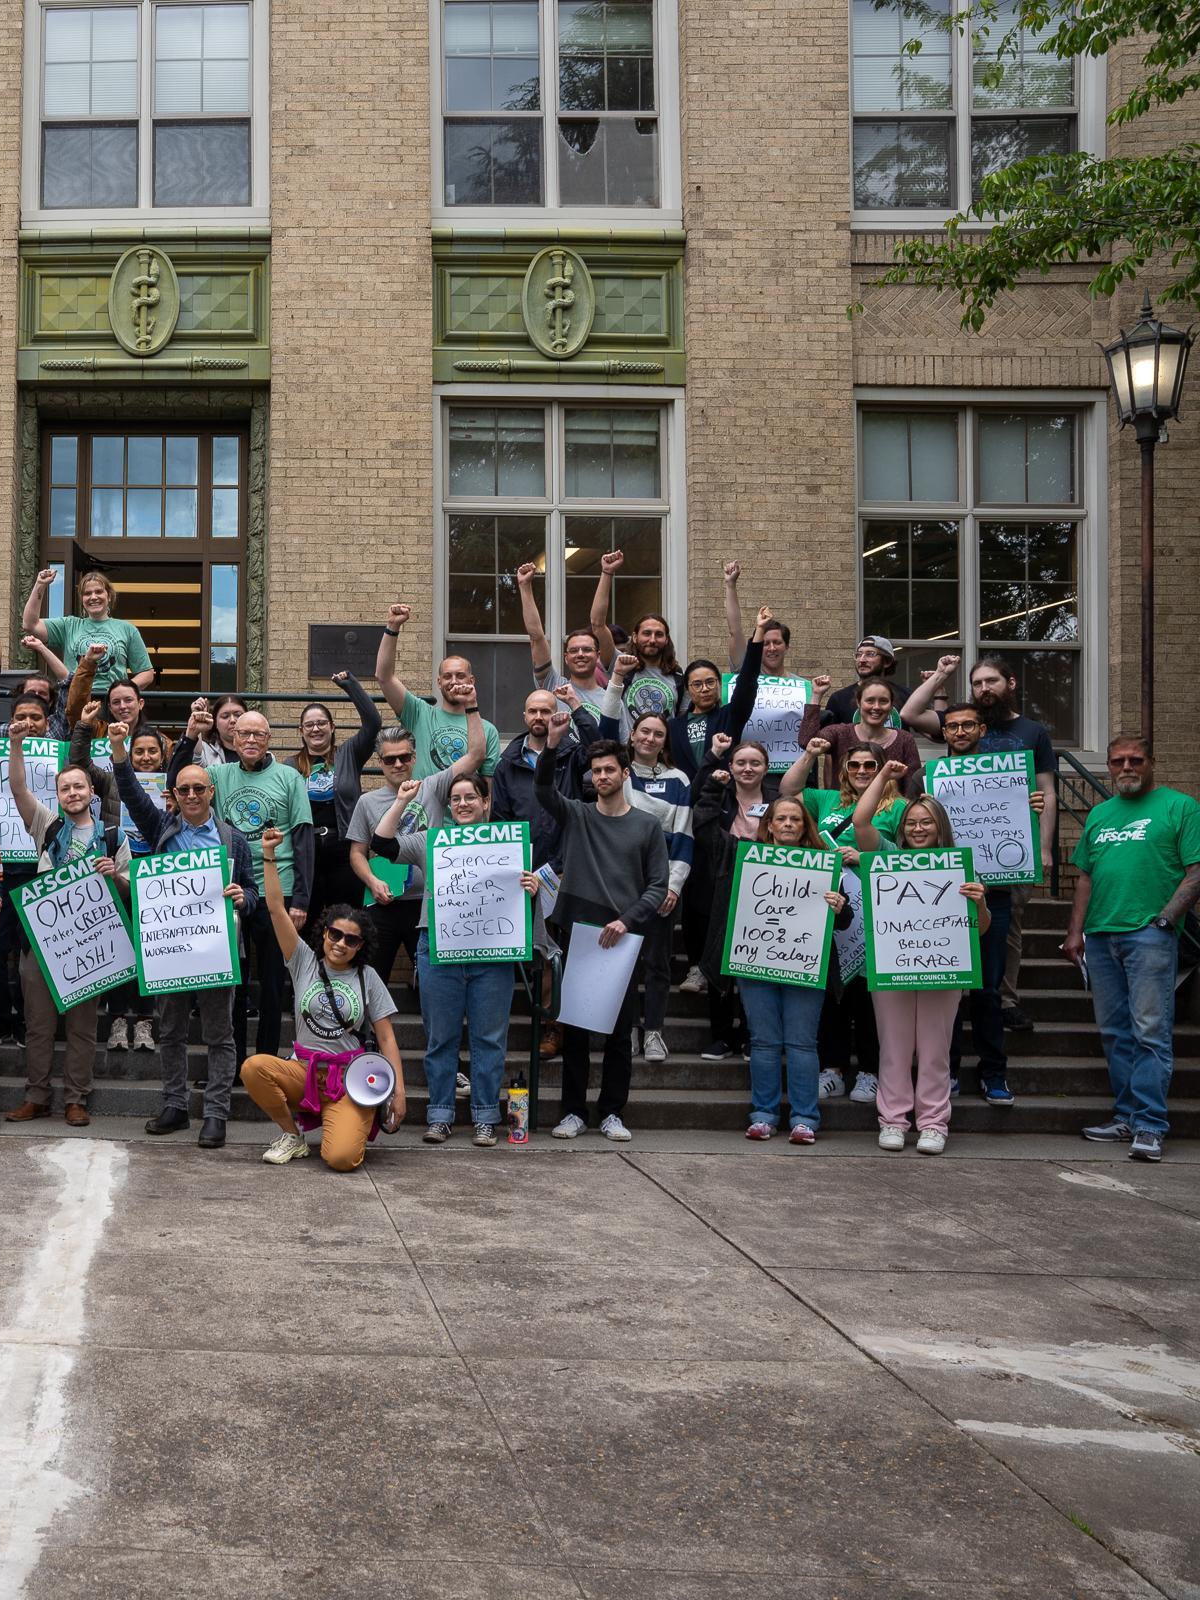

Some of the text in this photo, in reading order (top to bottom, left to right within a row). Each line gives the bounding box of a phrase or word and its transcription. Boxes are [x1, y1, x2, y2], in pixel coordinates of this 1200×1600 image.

[746, 719, 801, 733] ARVING
[933, 753, 1026, 776] AFSCME
[938, 775, 1032, 796] MY RESEARCH
[971, 802, 1010, 813] CURE
[951, 815, 1011, 828] DISEASES
[434, 824, 523, 846] AFSCME
[991, 829, 1025, 839] PAYS
[1095, 830, 1147, 844] AFSCME
[136, 848, 221, 877] AFSCME
[437, 848, 510, 869] Science
[744, 844, 836, 870] AFSCME
[870, 851, 963, 872] AFSCME
[21, 854, 98, 905] AFSCME
[451, 869, 478, 886] gets
[981, 872, 1021, 880] COUNCIL
[145, 876, 206, 900] OHSU
[437, 879, 505, 896] EASIER
[876, 874, 953, 906] PAY
[36, 879, 104, 928] OHSU
[140, 900, 215, 925] EXPLOITS
[437, 899, 469, 908] when
[754, 899, 798, 917] Care
[459, 907, 483, 919] well
[140, 924, 222, 943] INTERNATIONAL
[440, 917, 514, 939] RESTED
[742, 926, 812, 944] 100% of
[42, 928, 74, 948] takes
[54, 946, 73, 960] but
[107, 921, 124, 932] the
[898, 937, 951, 949] BELOW
[144, 943, 193, 958] WORKERS
[436, 950, 475, 958] OREGON
[476, 948, 515, 957] COUNCIL
[62, 940, 116, 981] CASH!
[895, 953, 960, 968] GRADE
[145, 979, 181, 990] OREGON
[183, 974, 221, 986] COUNCIL
[222, 972, 234, 980] 75
[728, 962, 766, 974] OREGON
[767, 968, 806, 981] COUNCIL
[807, 974, 819, 983] 75
[61, 984, 96, 1005] OREGON
[95, 970, 130, 988] COUNCIL
[130, 966, 136, 974] 7
[331, 982, 351, 994] ORKERS
[306, 1018, 328, 1036] OREGON
